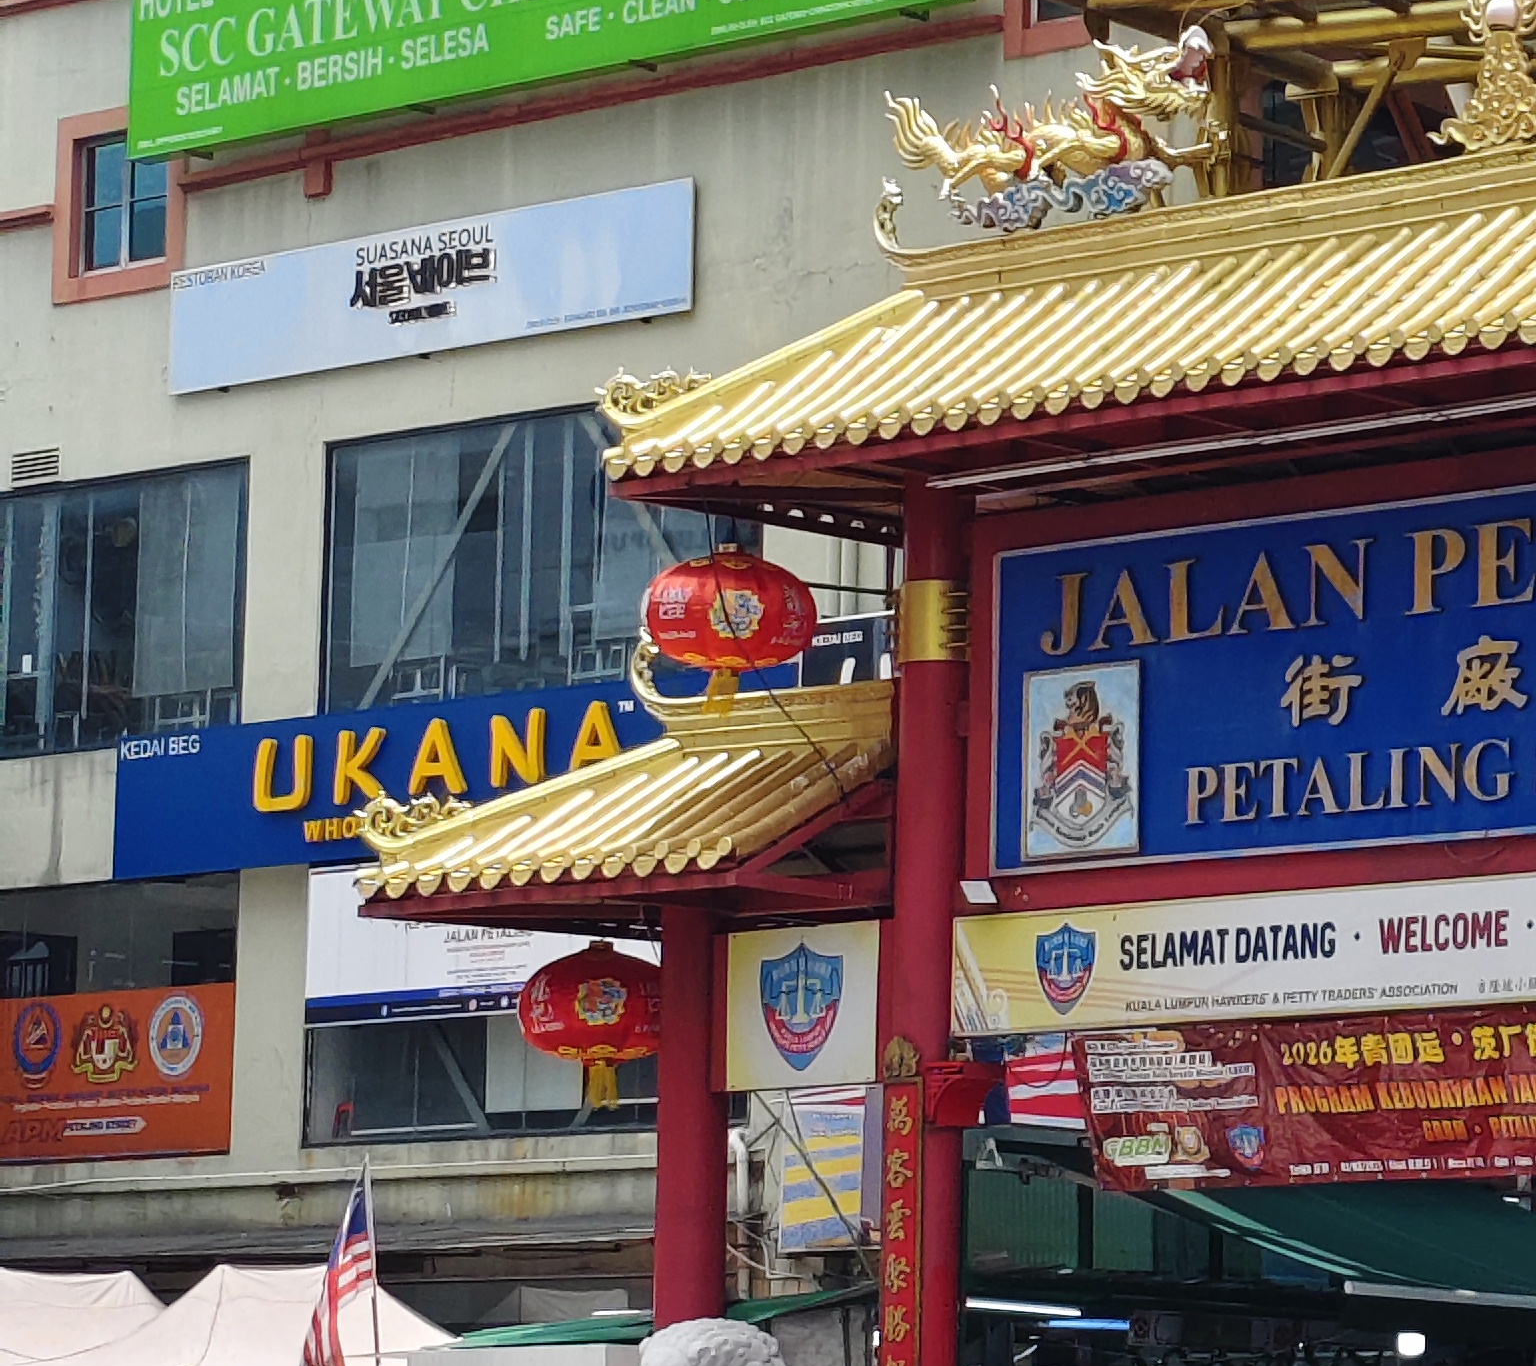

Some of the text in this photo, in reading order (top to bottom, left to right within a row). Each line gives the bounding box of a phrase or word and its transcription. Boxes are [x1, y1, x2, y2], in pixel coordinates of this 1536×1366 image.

[160, 16, 237, 77] SCC
[545, 6, 602, 40] SAFE
[176, 23, 490, 115] SELAMAT BERSIH SELESA
[356, 223, 493, 266] SUASANA SEOUL
[1040, 538, 1374, 656] JALAN
[119, 734, 200, 761] KEDAI BEG
[252, 701, 621, 813] UKANA
[1184, 738, 1512, 826] PETALING
[1119, 909, 1509, 971] SELAMAT DATANG WELCOME
[1125, 997, 1162, 1013] KUALA
[1379, 982, 1459, 999] ASSOCIATION
[1274, 1084, 1375, 1115] PROGRAM
[1376, 1075, 1508, 1111] KEBUDAYAAN
